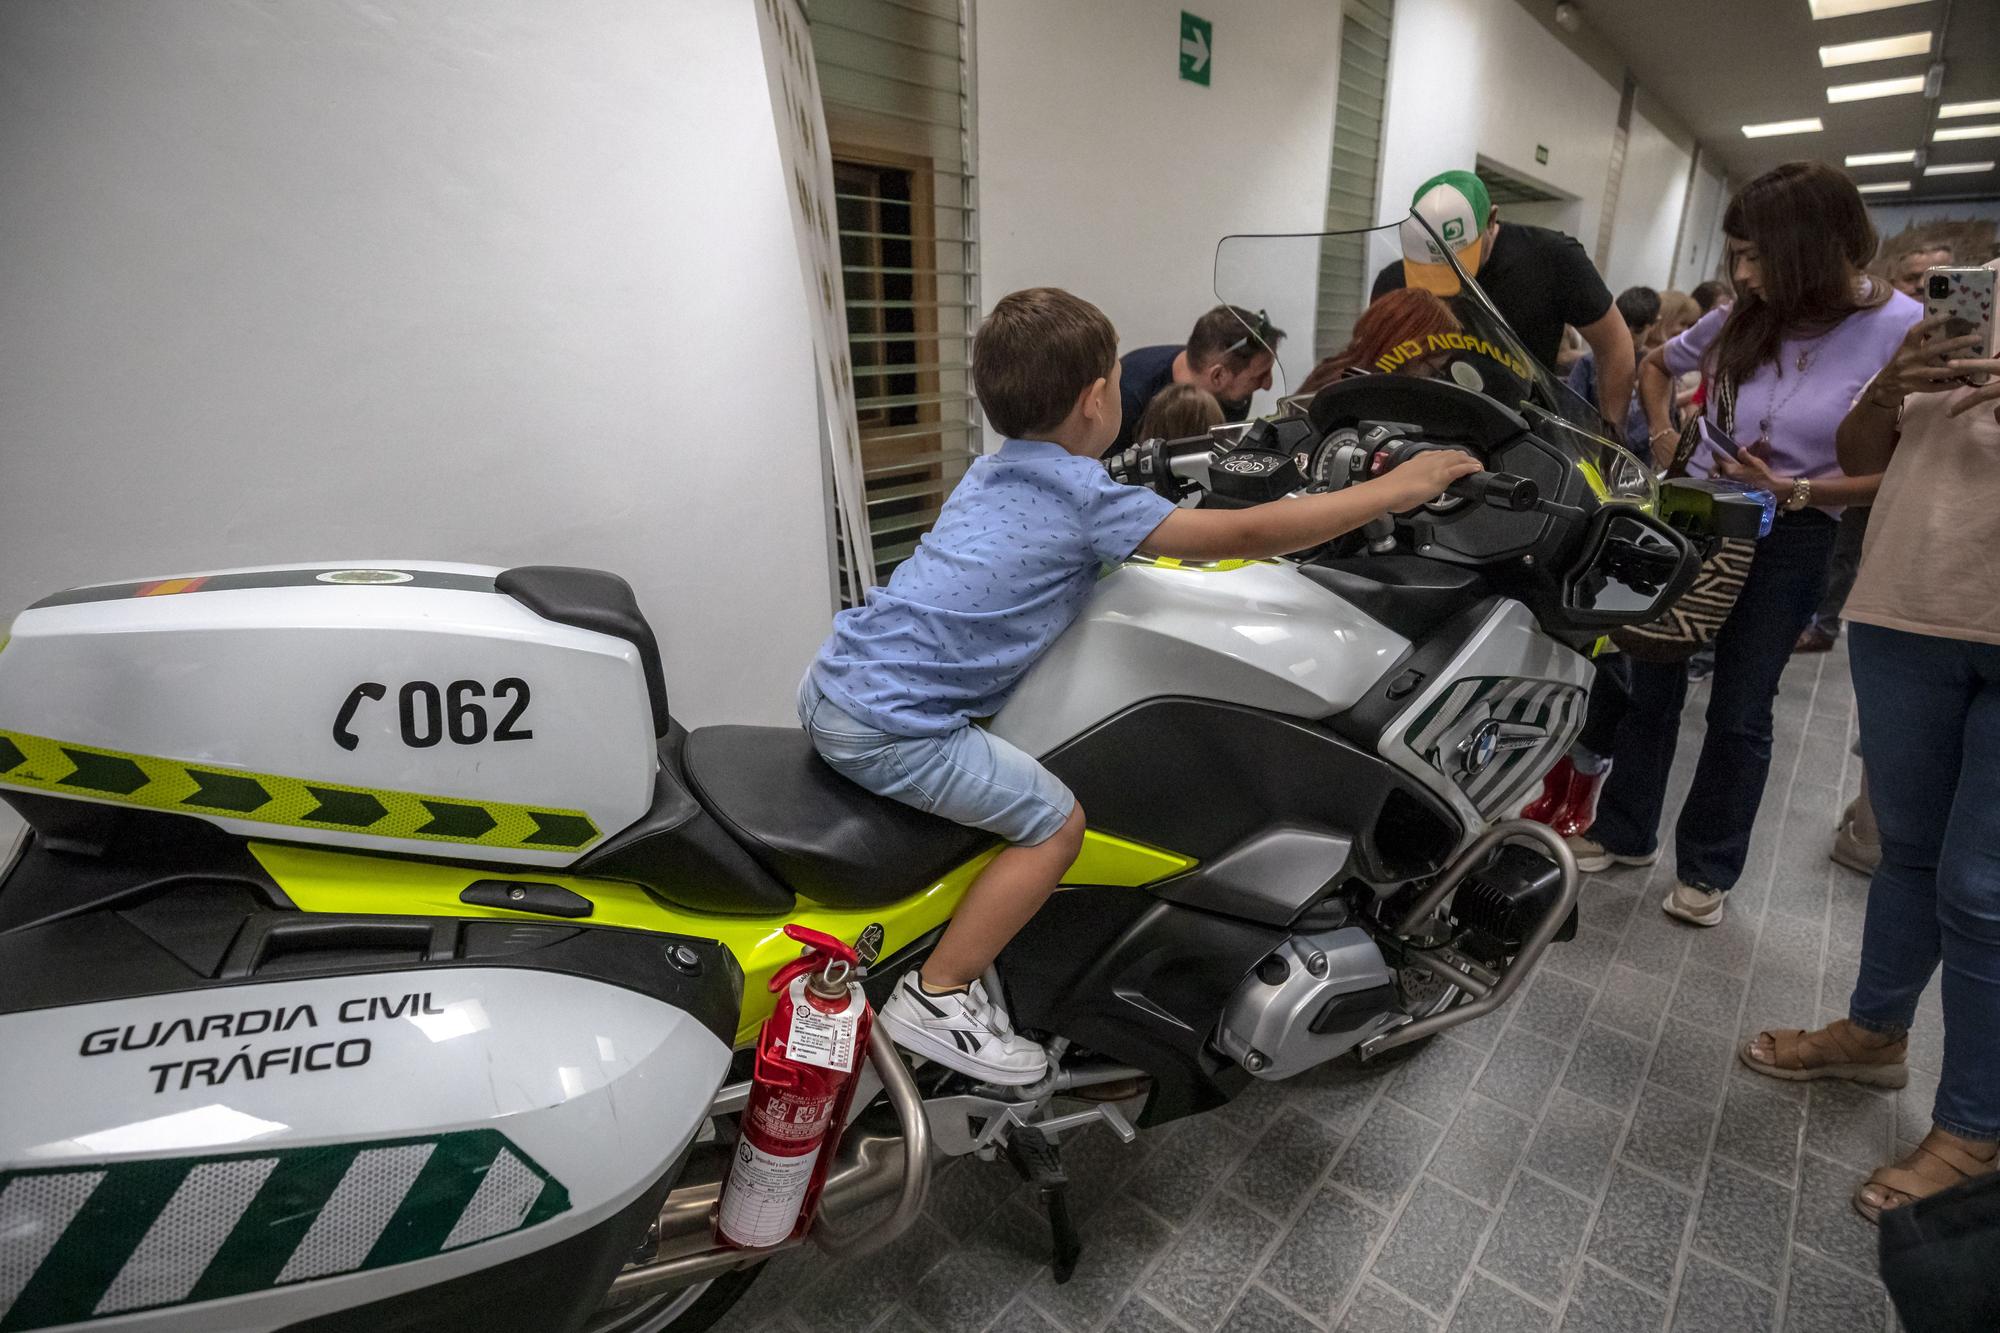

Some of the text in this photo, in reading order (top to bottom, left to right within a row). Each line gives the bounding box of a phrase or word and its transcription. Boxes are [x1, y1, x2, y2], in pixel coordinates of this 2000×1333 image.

[398, 677, 533, 748] 062
[79, 992, 445, 1057] GUARDIA CIVIL
[148, 1038, 372, 1094] TRÁFICO
